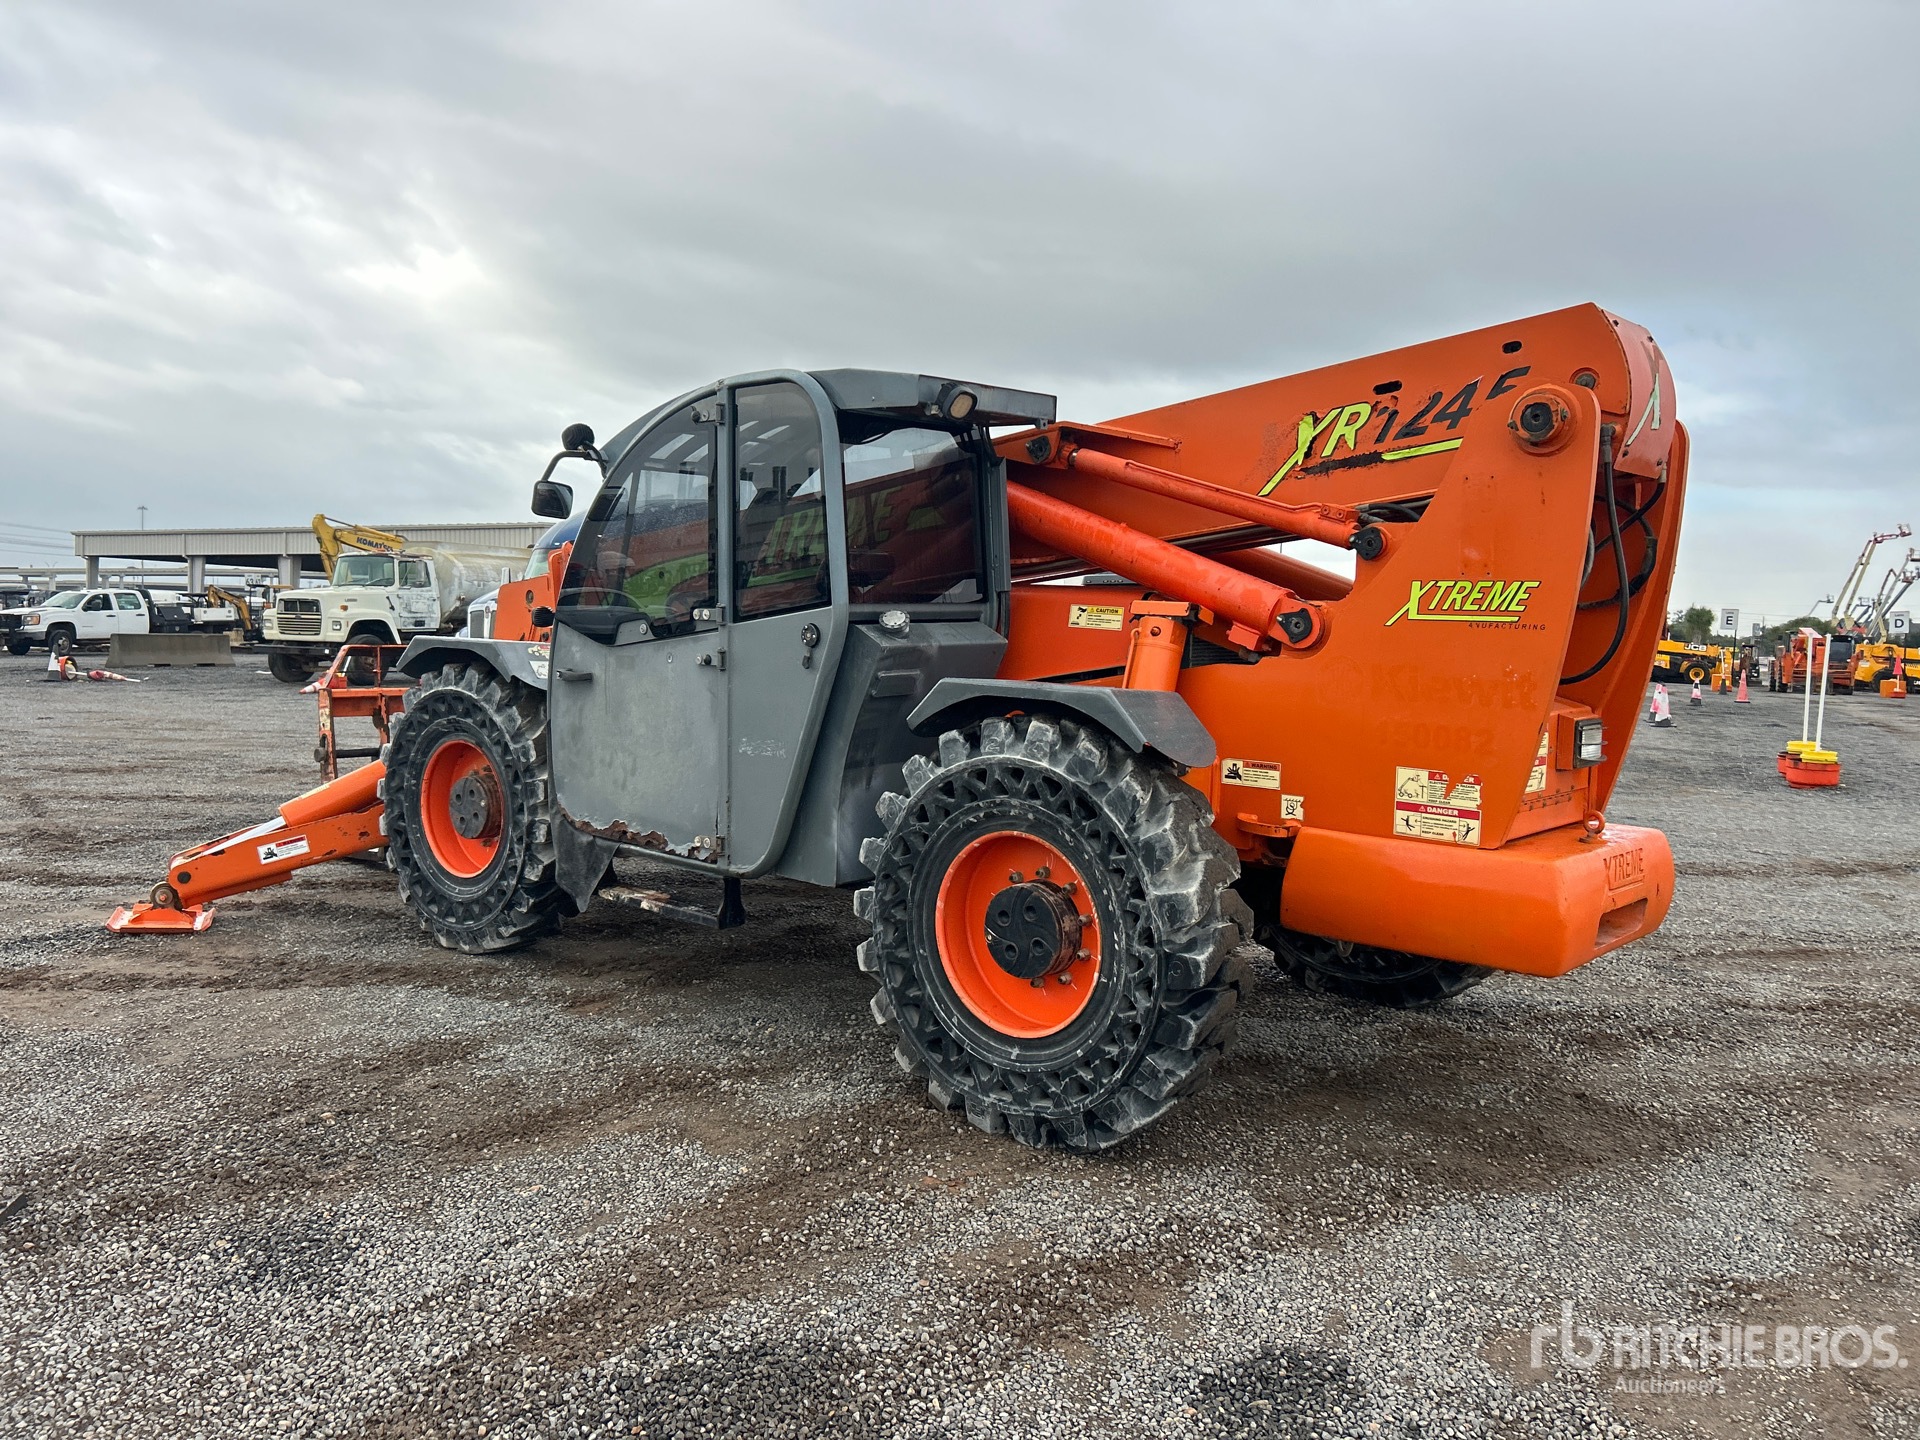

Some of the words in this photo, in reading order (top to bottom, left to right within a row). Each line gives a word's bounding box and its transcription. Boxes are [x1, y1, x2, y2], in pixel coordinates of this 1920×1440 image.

[1384, 580, 1542, 627] XTREME
[1725, 615, 1734, 626] E
[1894, 618, 1905, 629] D
[1684, 643, 1707, 652] JCB
[1427, 807, 1459, 816] DANGER
[1602, 847, 1645, 890] XTREME
